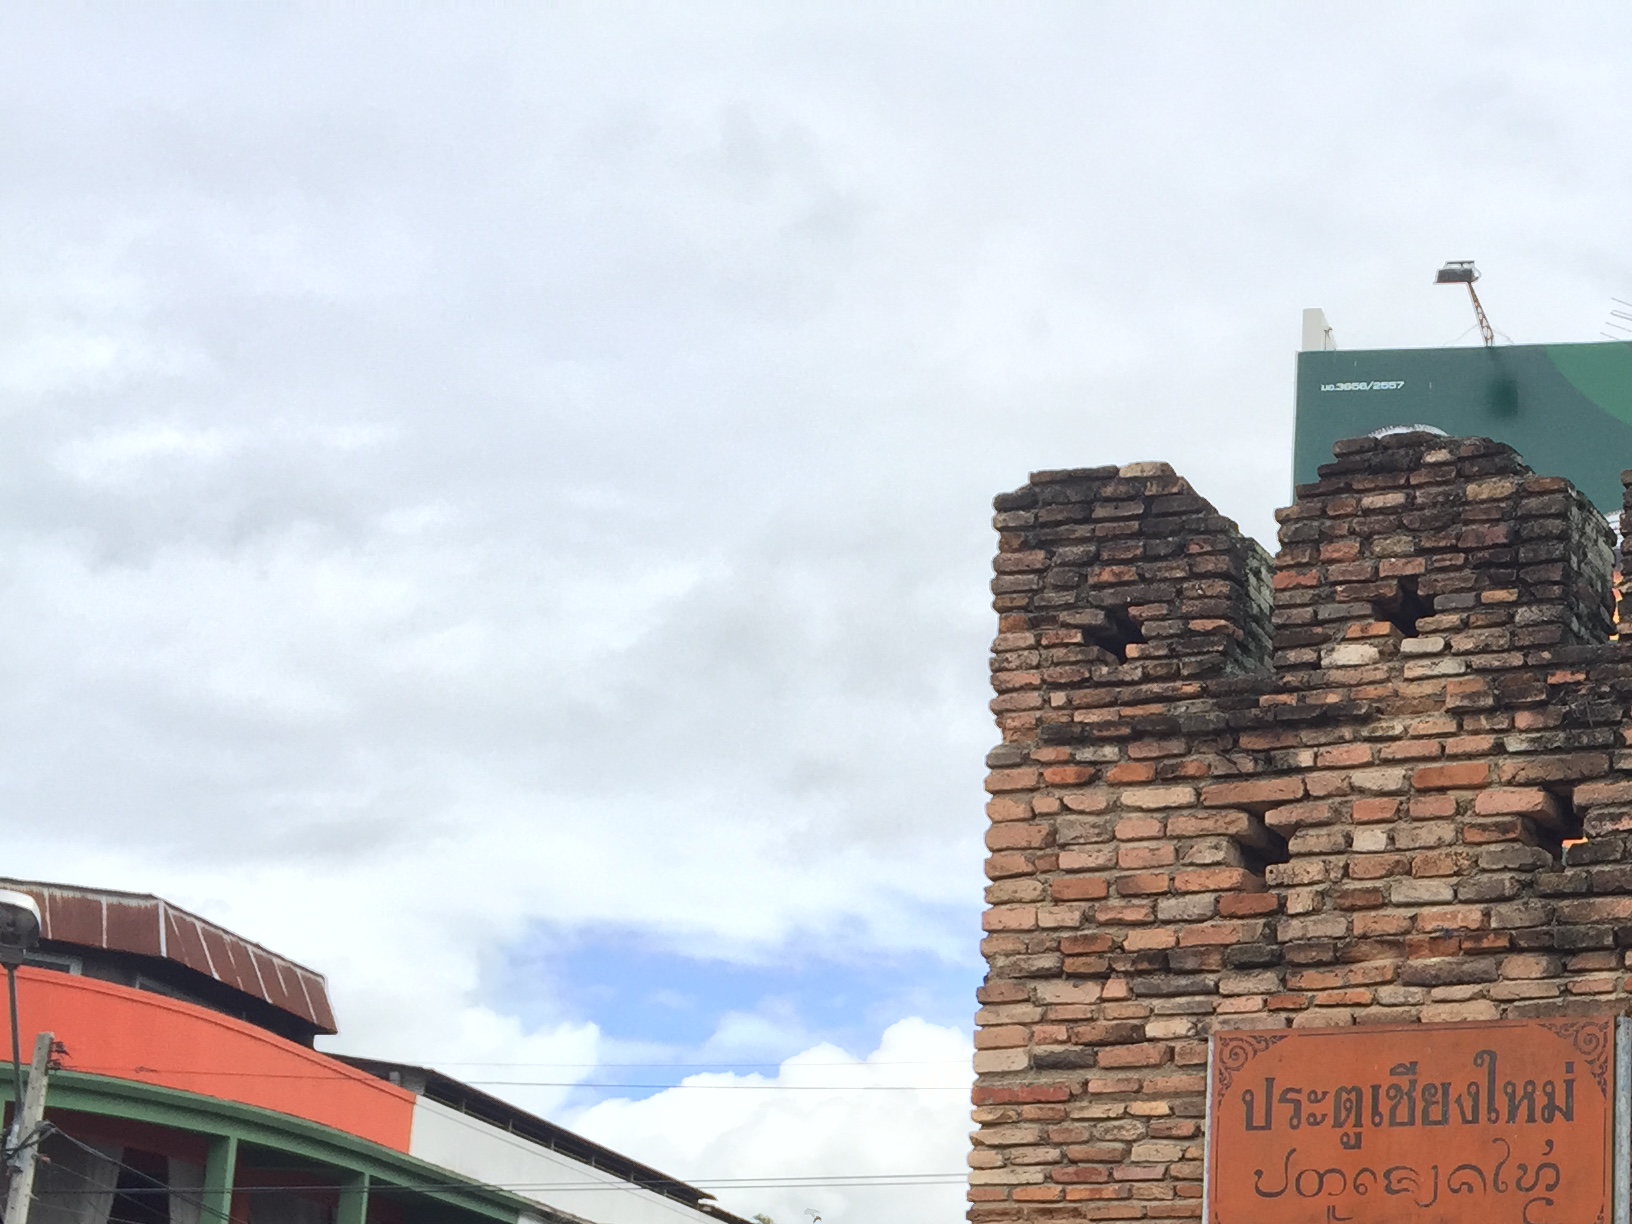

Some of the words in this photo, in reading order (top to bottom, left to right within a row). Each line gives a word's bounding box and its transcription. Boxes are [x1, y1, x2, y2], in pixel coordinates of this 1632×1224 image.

[1242, 1050, 1576, 1150] ประตูเชียงใหม่
